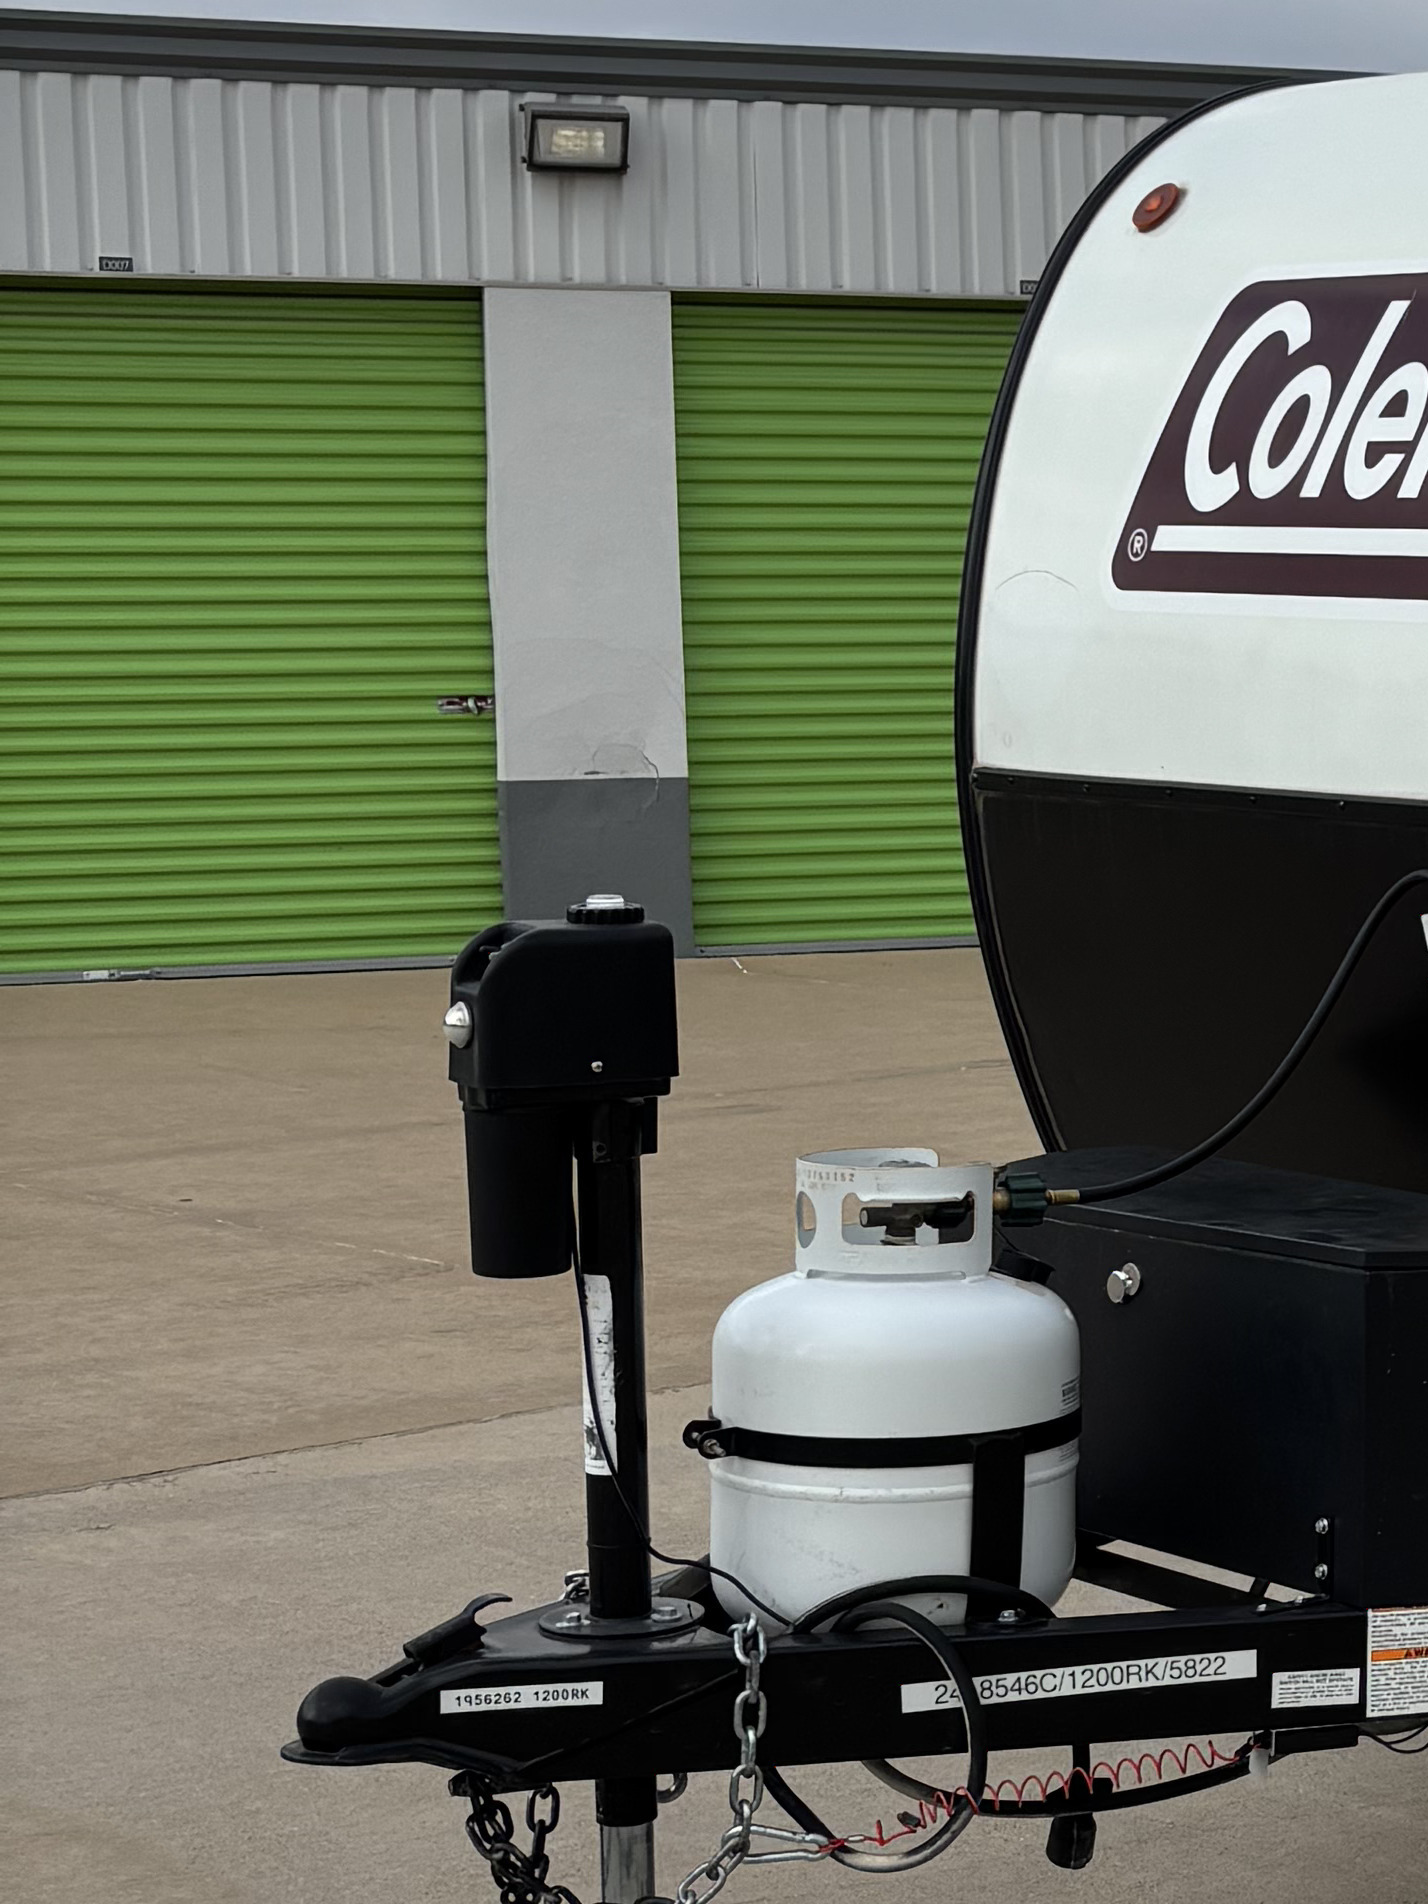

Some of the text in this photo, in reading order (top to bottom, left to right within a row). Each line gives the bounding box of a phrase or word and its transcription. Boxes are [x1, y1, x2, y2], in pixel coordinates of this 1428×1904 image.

[934, 1655, 1227, 1704] 248546C/1200RK/5822
[455, 1688, 590, 1707] 1956262 1200RK
